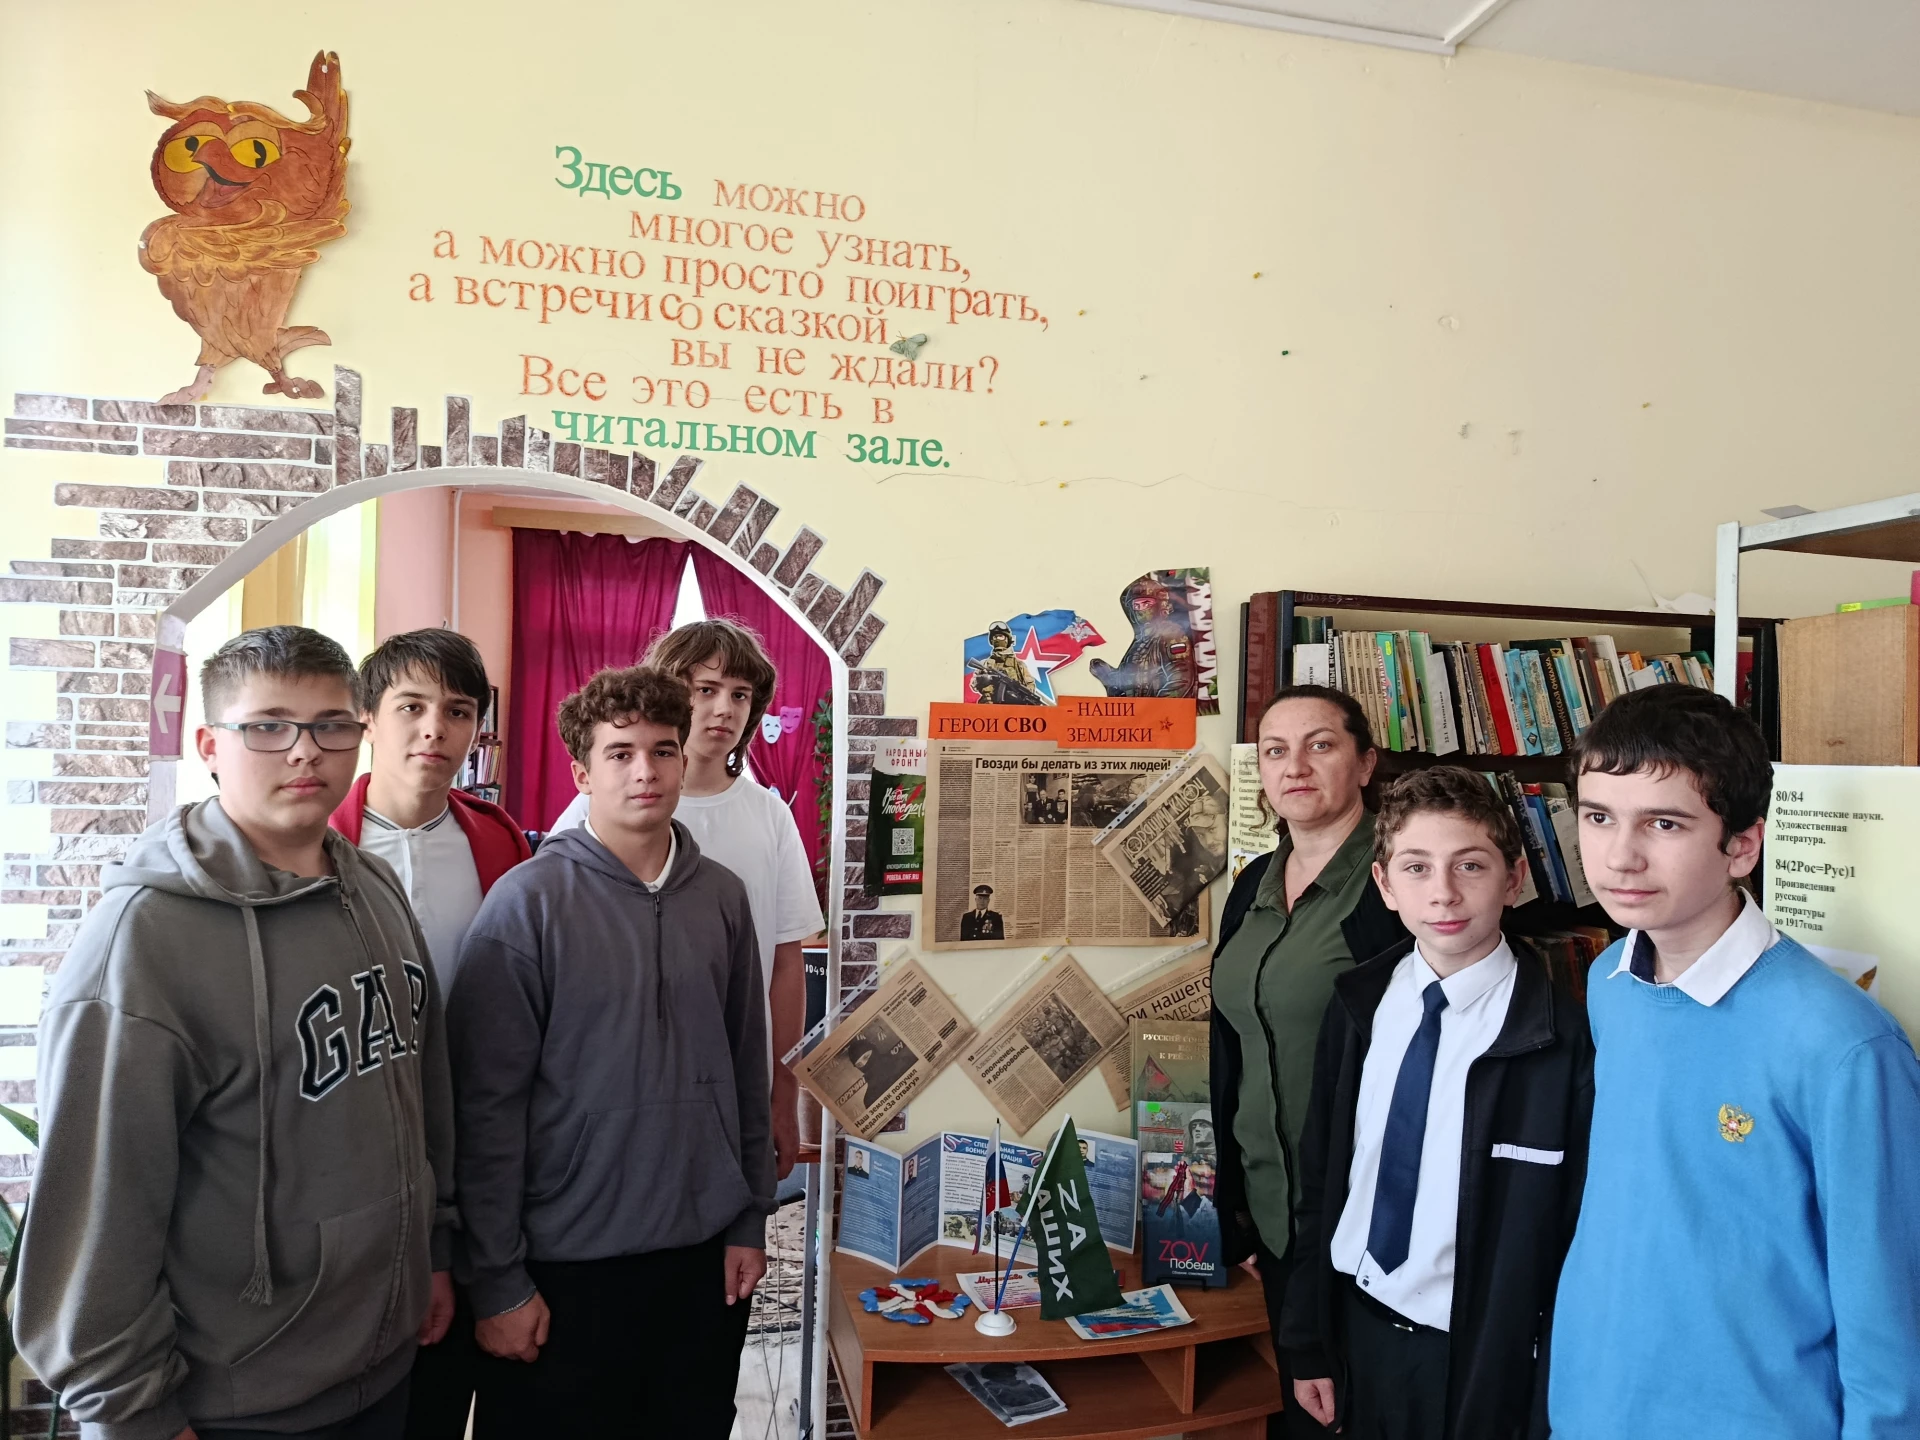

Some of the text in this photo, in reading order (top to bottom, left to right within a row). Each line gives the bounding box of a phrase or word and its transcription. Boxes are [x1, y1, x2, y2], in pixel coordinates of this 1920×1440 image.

[555, 145, 866, 222] Здесь можно
[629, 210, 971, 283] многое узнать,
[433, 230, 1049, 332] а можно просто поиграть,
[408, 272, 889, 344] а встречи со сказкой
[670, 338, 999, 394] вы не ждали?
[518, 354, 894, 424] Все это есть в
[551, 410, 950, 468] читальном зале.
[1078, 703, 1135, 717] НАШИ
[938, 716, 1047, 733] ГЕРОИ СВО
[1066, 727, 1152, 743] ЗЕМЛЯКИ
[891, 758, 918, 767] ФРОНТ
[975, 757, 1171, 772] Гвозди бы делать из этих людей!
[1775, 790, 1803, 802] 80/84
[1775, 806, 1884, 822] Филологические науки.
[1775, 819, 1847, 832] Художественная
[1775, 833, 1826, 846] литература.
[1775, 858, 1856, 879] 84(2Рос=Рус)1
[1775, 877, 1836, 893] Произведения
[1774, 892, 1807, 903] русской
[1774, 904, 1826, 919] литературы
[1774, 917, 1823, 931] до 1917года
[979, 1045, 1015, 1078] ополченец
[990, 1043, 1029, 1081] доброволец
[854, 1067, 918, 1128] Наш земляк получил
[859, 1109, 884, 1134] медаль
[894, 1075, 922, 1101] отвагу»
[1158, 1239, 1209, 1262] ZOV
[1170, 1258, 1215, 1271] Победы
